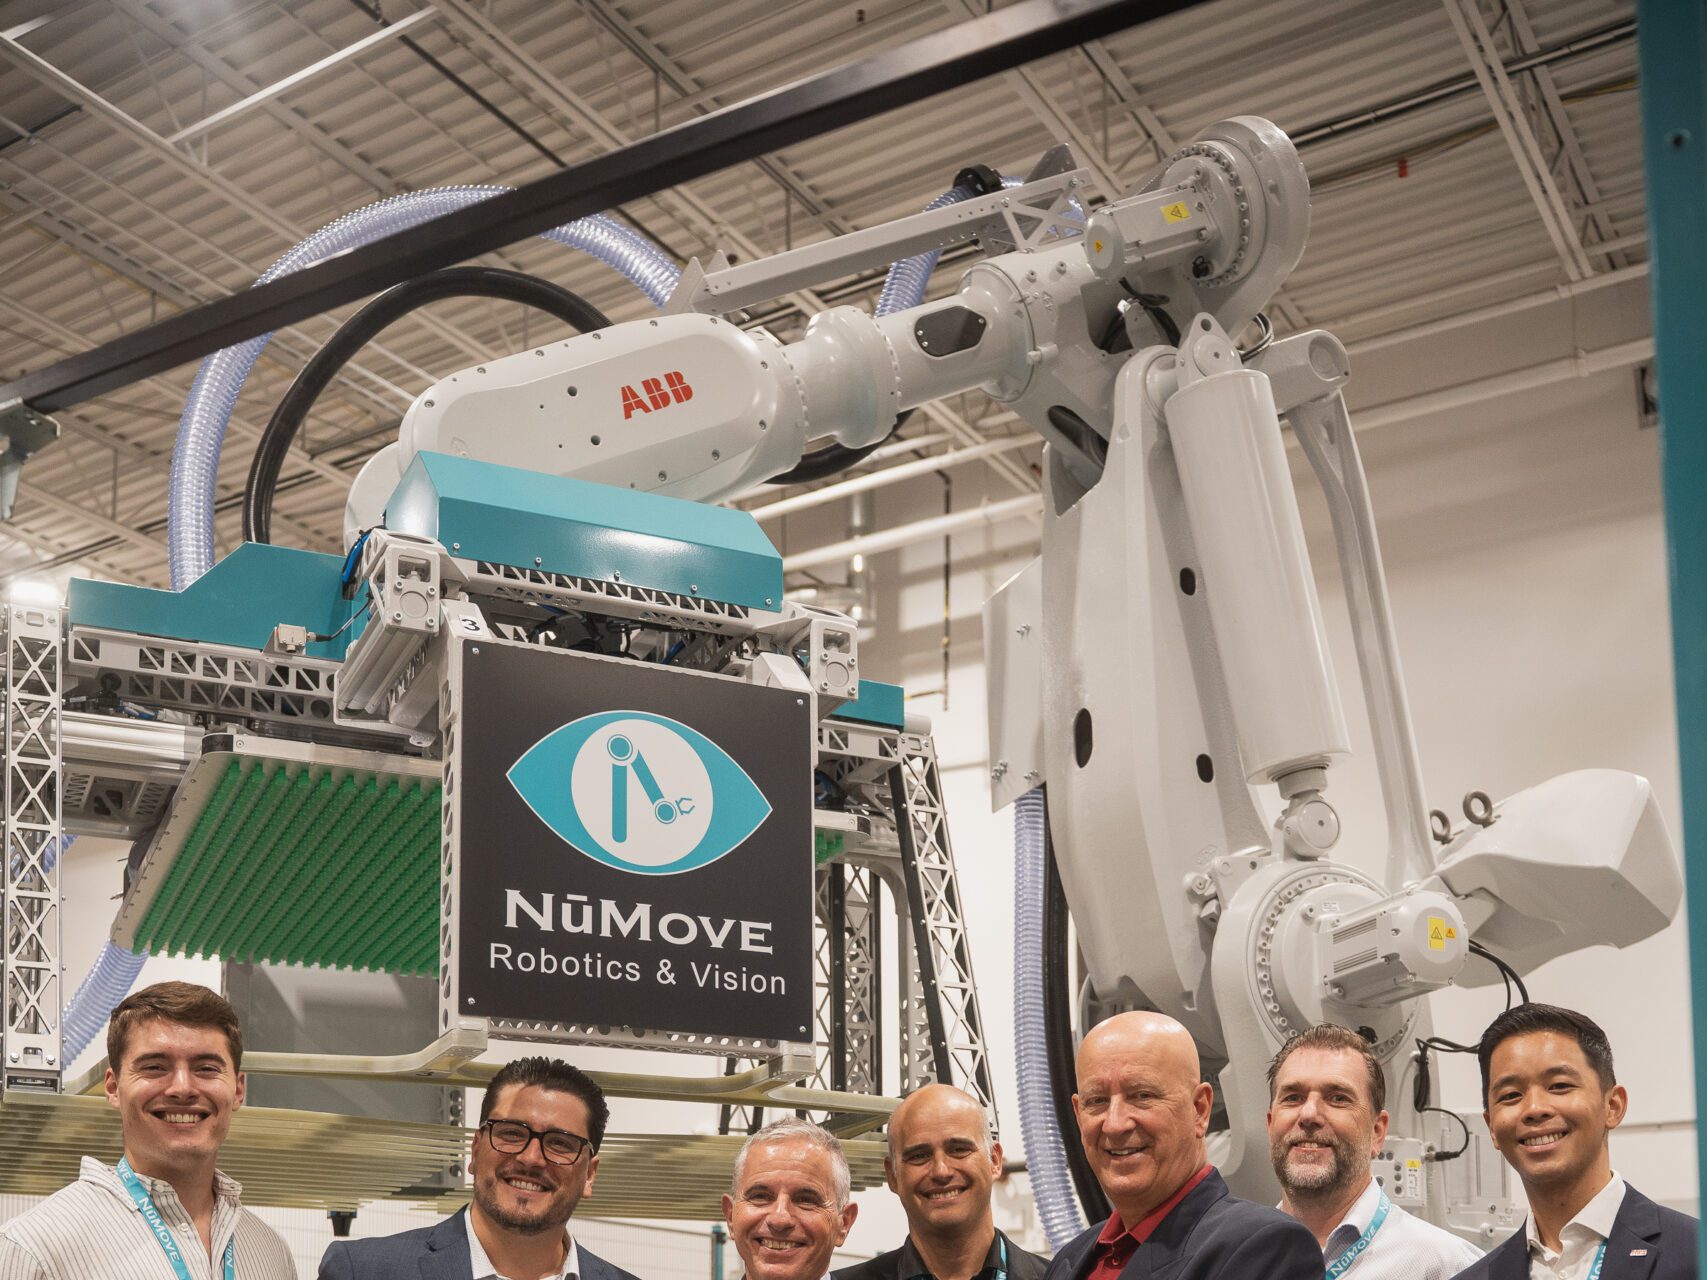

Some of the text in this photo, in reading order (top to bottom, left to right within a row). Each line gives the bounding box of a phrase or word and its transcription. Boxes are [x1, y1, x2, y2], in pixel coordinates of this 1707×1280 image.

[620, 371, 694, 421] ABB
[461, 618, 481, 632] 3
[489, 942, 787, 995] Robotics & Vision
